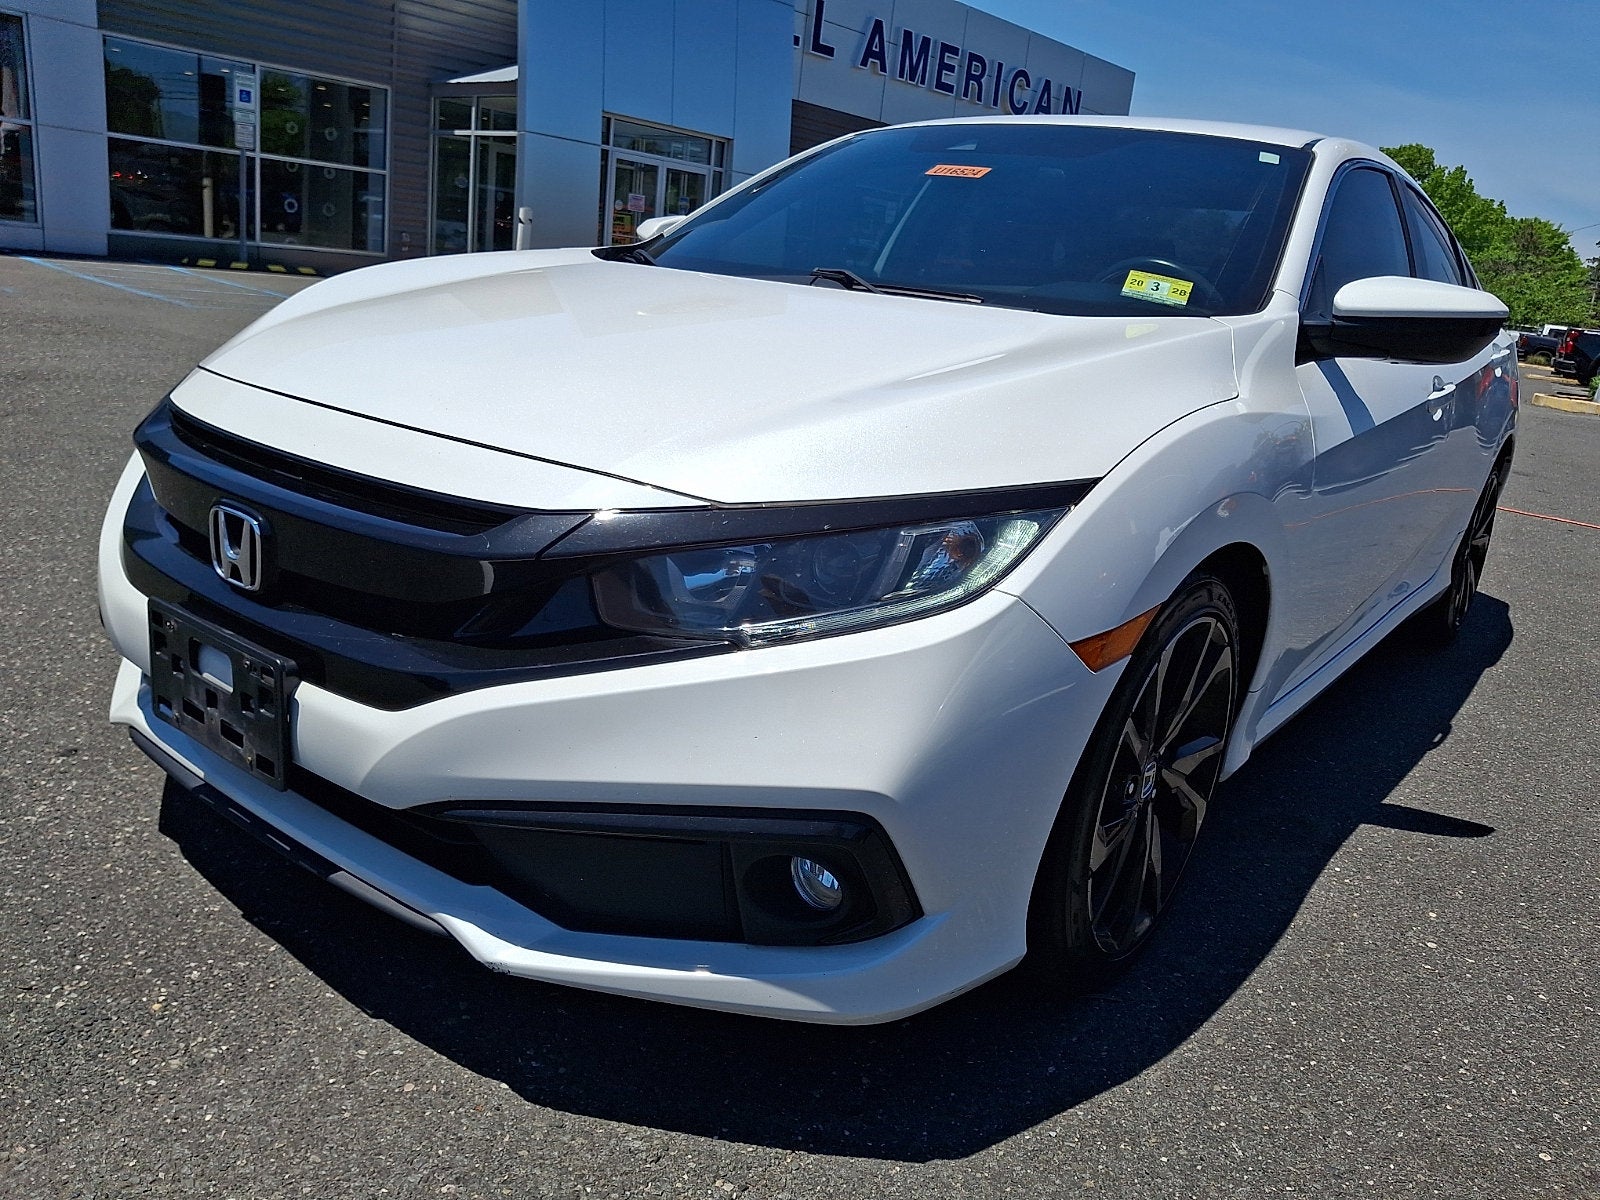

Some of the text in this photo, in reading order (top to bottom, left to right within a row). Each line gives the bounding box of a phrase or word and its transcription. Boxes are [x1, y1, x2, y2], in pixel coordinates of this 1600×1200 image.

[858, 17, 1083, 116] AMERICAN
[1129, 278, 1144, 287] 20
[1150, 281, 1161, 292] 3
[1171, 287, 1187, 297] 28
